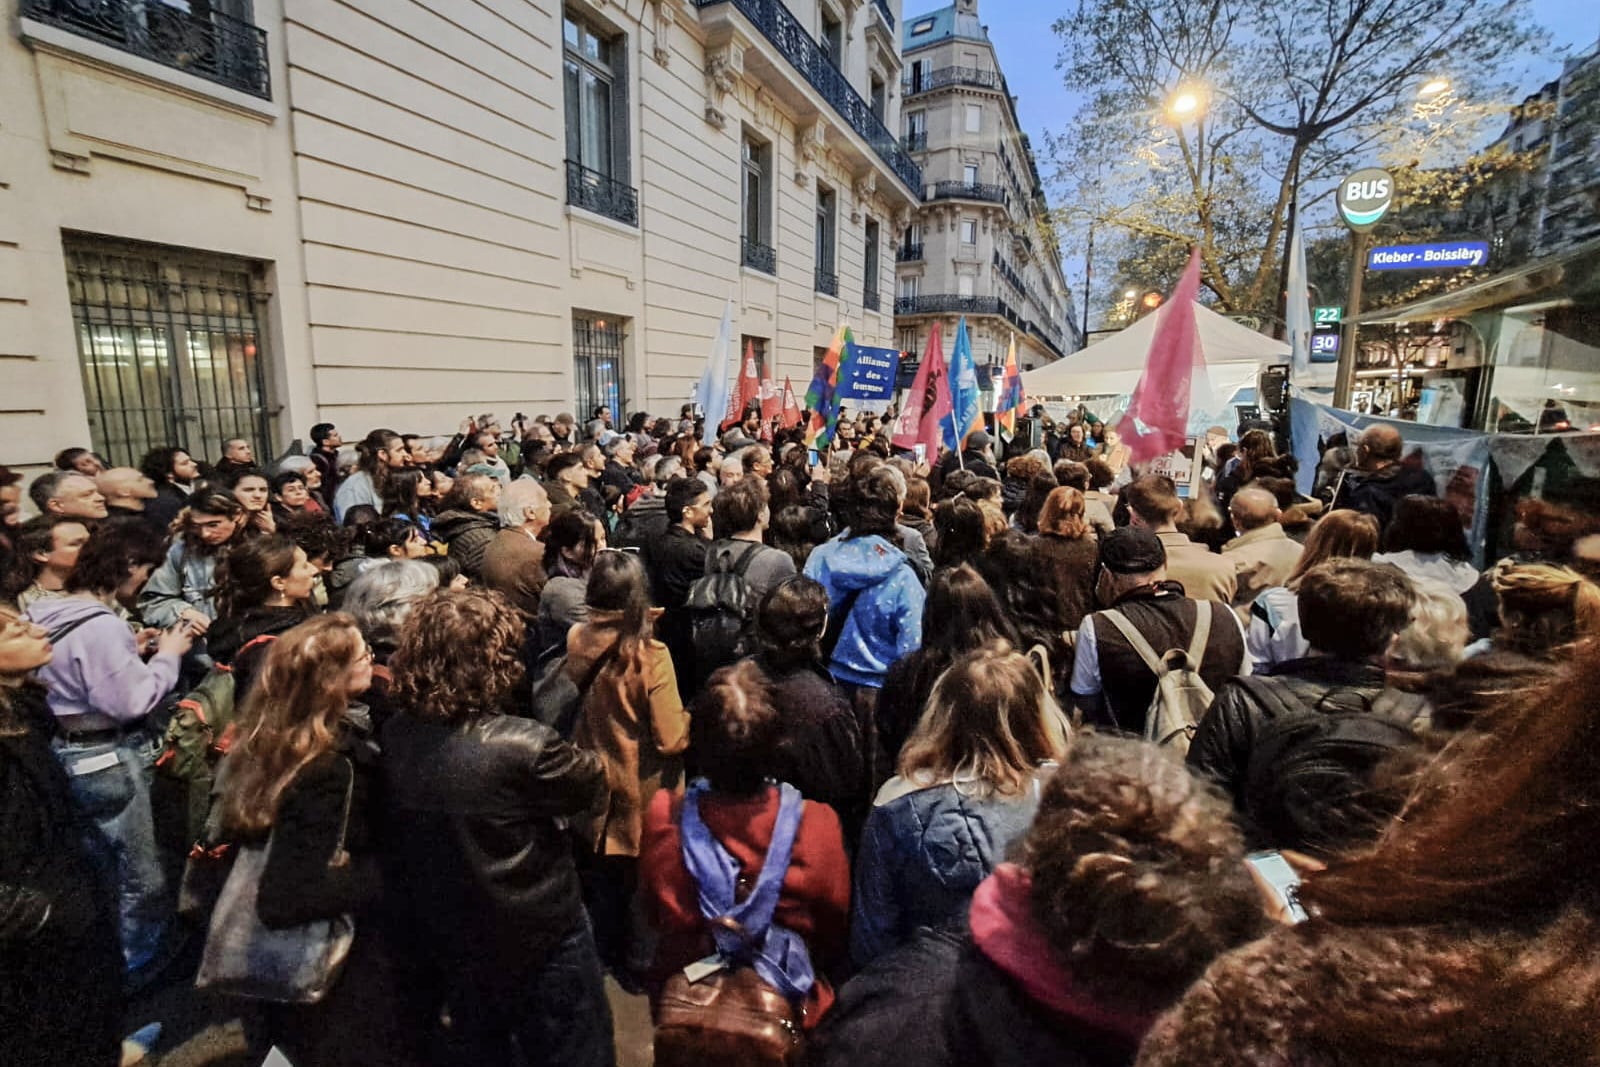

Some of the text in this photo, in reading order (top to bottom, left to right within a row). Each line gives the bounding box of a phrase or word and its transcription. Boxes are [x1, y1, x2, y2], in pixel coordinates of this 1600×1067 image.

[1346, 180, 1389, 201] BUS
[1373, 252, 1415, 264] Kleber
[1318, 309, 1338, 321] 22
[1315, 336, 1334, 349] 30
[856, 356, 890, 368] Alliance
[866, 370, 881, 380] des
[853, 382, 883, 392] femmes
